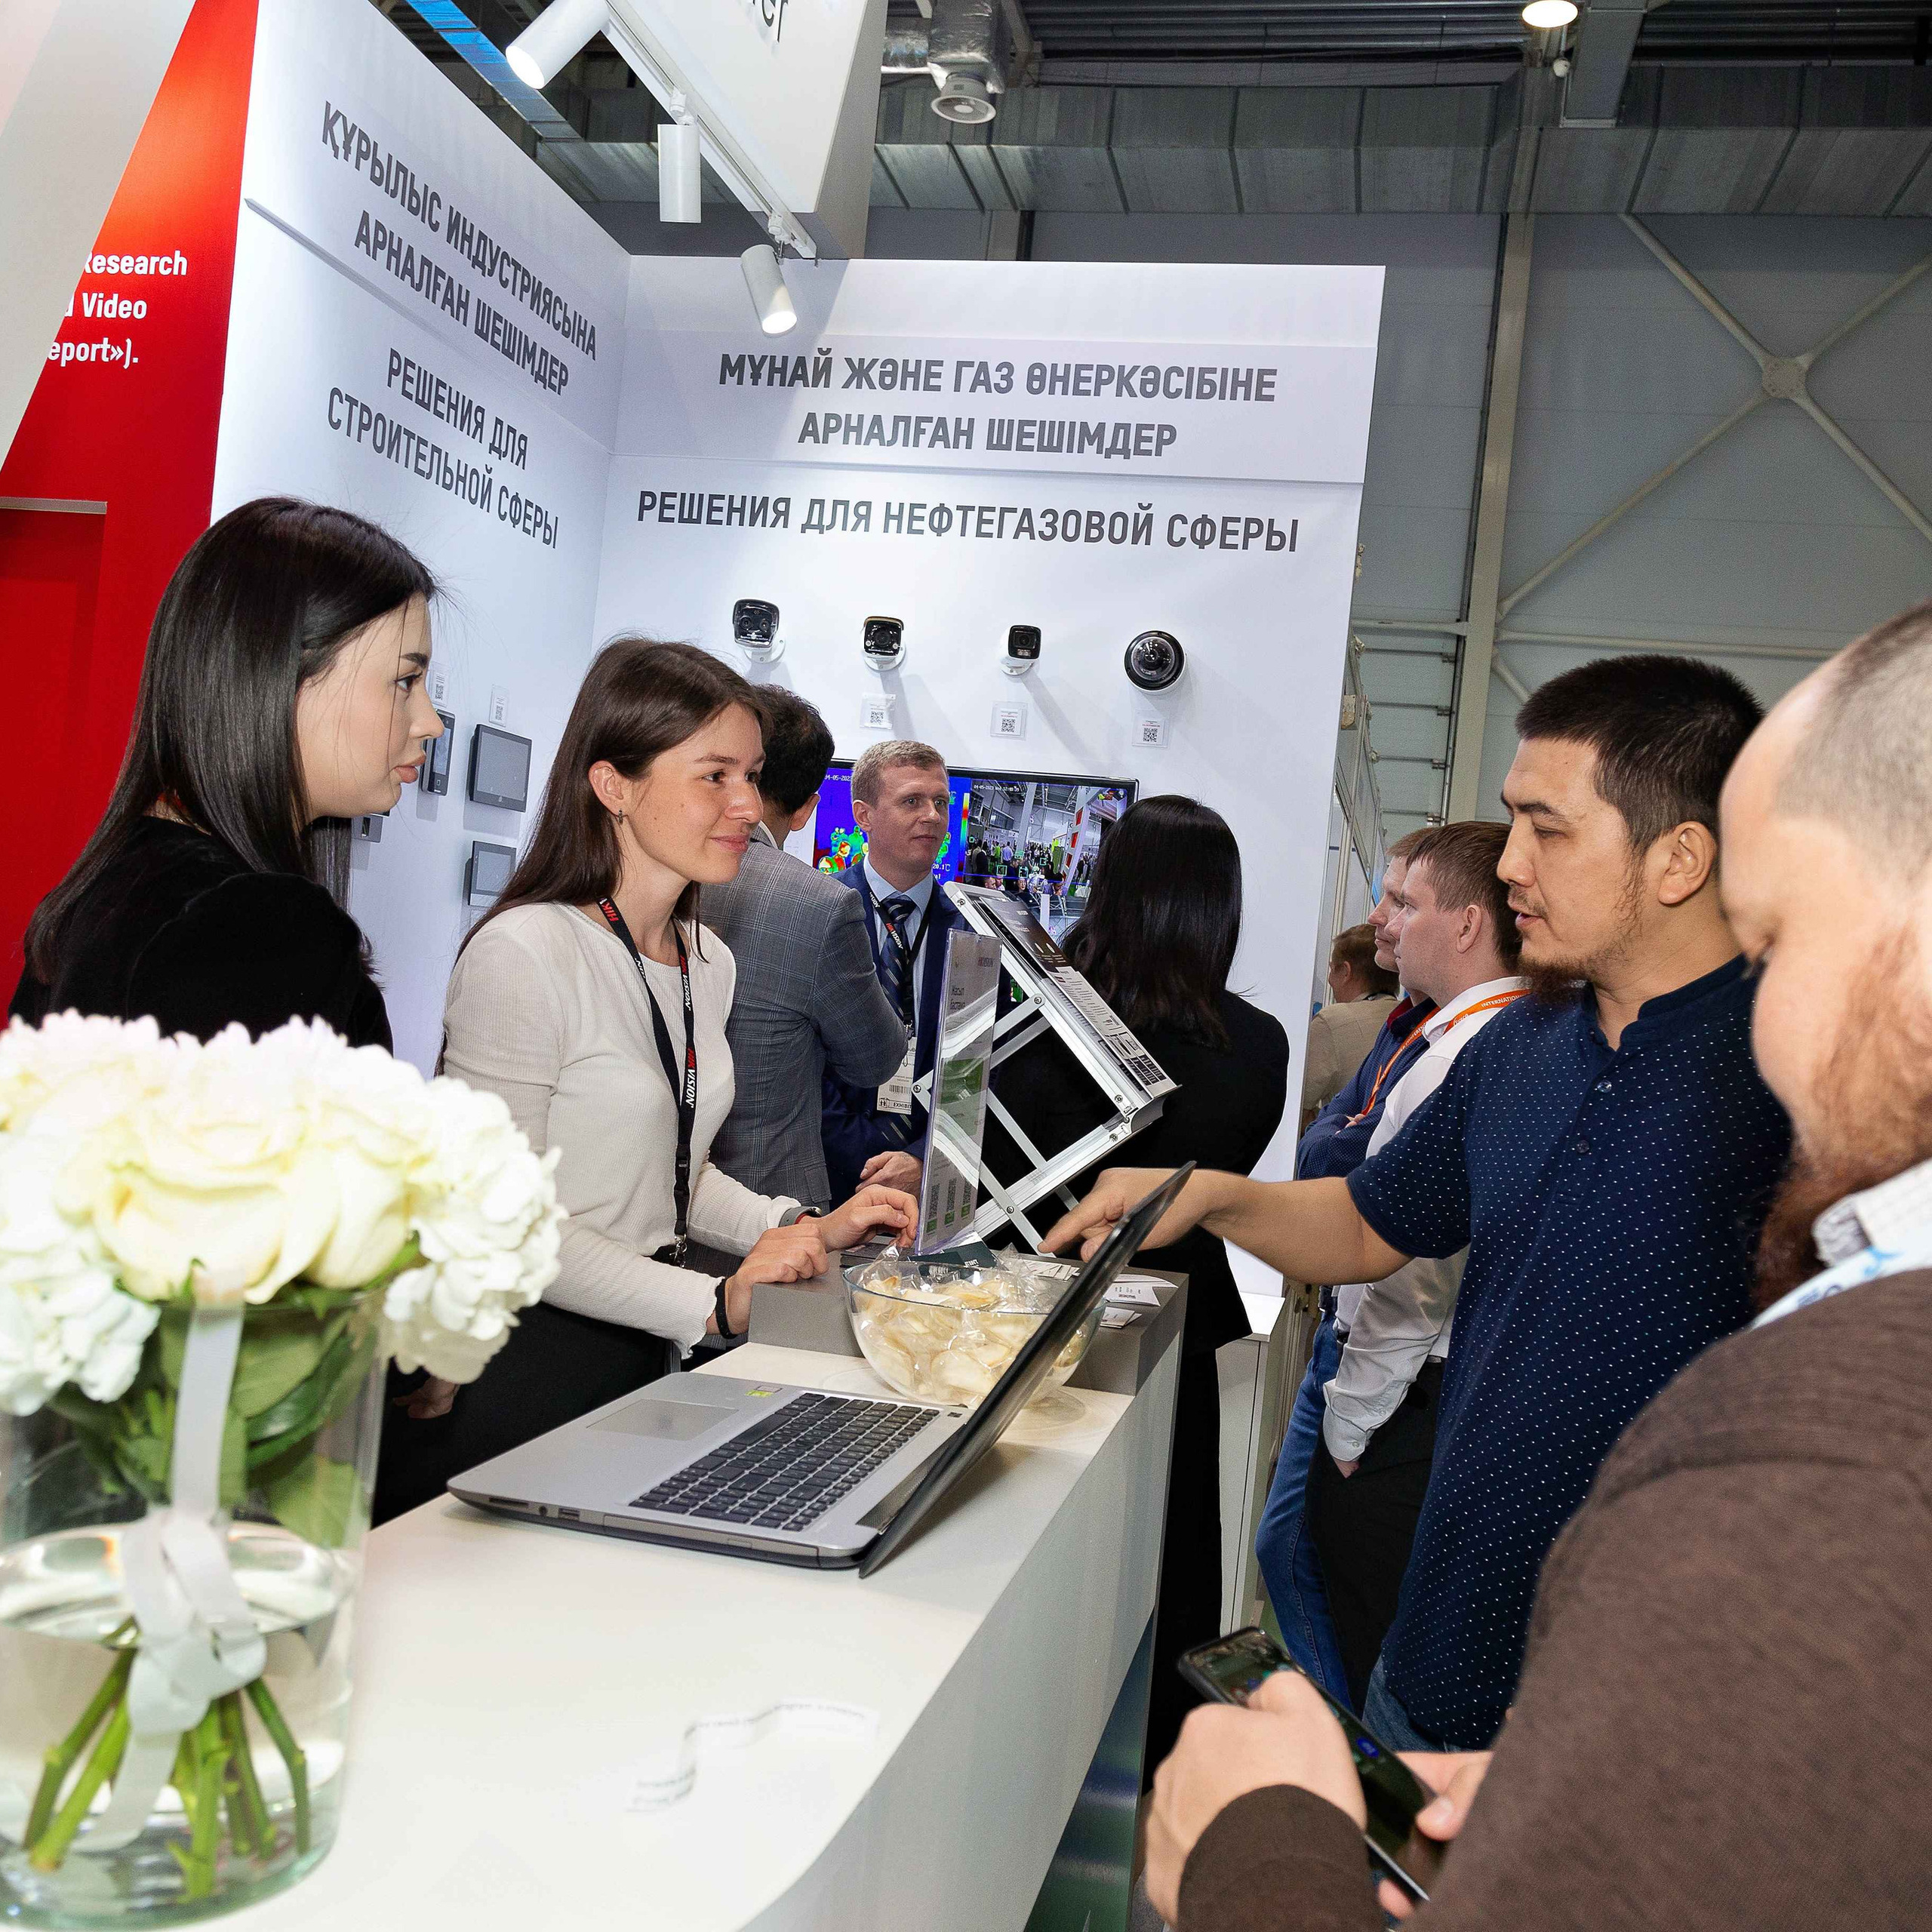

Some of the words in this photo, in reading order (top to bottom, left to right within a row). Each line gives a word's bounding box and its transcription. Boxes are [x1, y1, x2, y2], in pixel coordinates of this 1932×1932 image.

[323, 101, 442, 233] ҚҰРЫЛЫС
[447, 205, 597, 361] ИНДУСТРИЯСЫНА
[82, 292, 147, 319] Video
[355, 211, 469, 327] АРНАЛҒАН
[475, 298, 569, 396] ШЕШІМДЕР
[48, 337, 139, 369] eport»).
[719, 348, 833, 389] МҰНАЙ
[841, 358, 944, 392] ЖӘНЕ
[953, 360, 1014, 394] ГАЗ
[1026, 362, 1278, 402] ӨНЕРКӘСІБІНЕ
[386, 347, 485, 445] РЕШЕНИЯ
[489, 416, 528, 470] ДЛЯ
[798, 412, 975, 451] АРНАЛҒАН
[986, 419, 1177, 459] ШЕШІМДЕР
[328, 387, 494, 514] СТРОИТЕЛЬНОЙ
[498, 485, 558, 549] СФЕРЫ
[638, 491, 791, 528] РЕШЕНИЯ
[801, 498, 871, 535] ДЛЯ
[884, 502, 1155, 546] НЕФТЕГАЗОВОЙ
[1167, 513, 1300, 553] СФЕРЫ
[886, 922, 903, 949] HIKVISION
[680, 955, 693, 1011] HIKVISION
[1481, 995, 1524, 1008] INTERNATIO
[685, 1047, 696, 1109] HIKVISION
